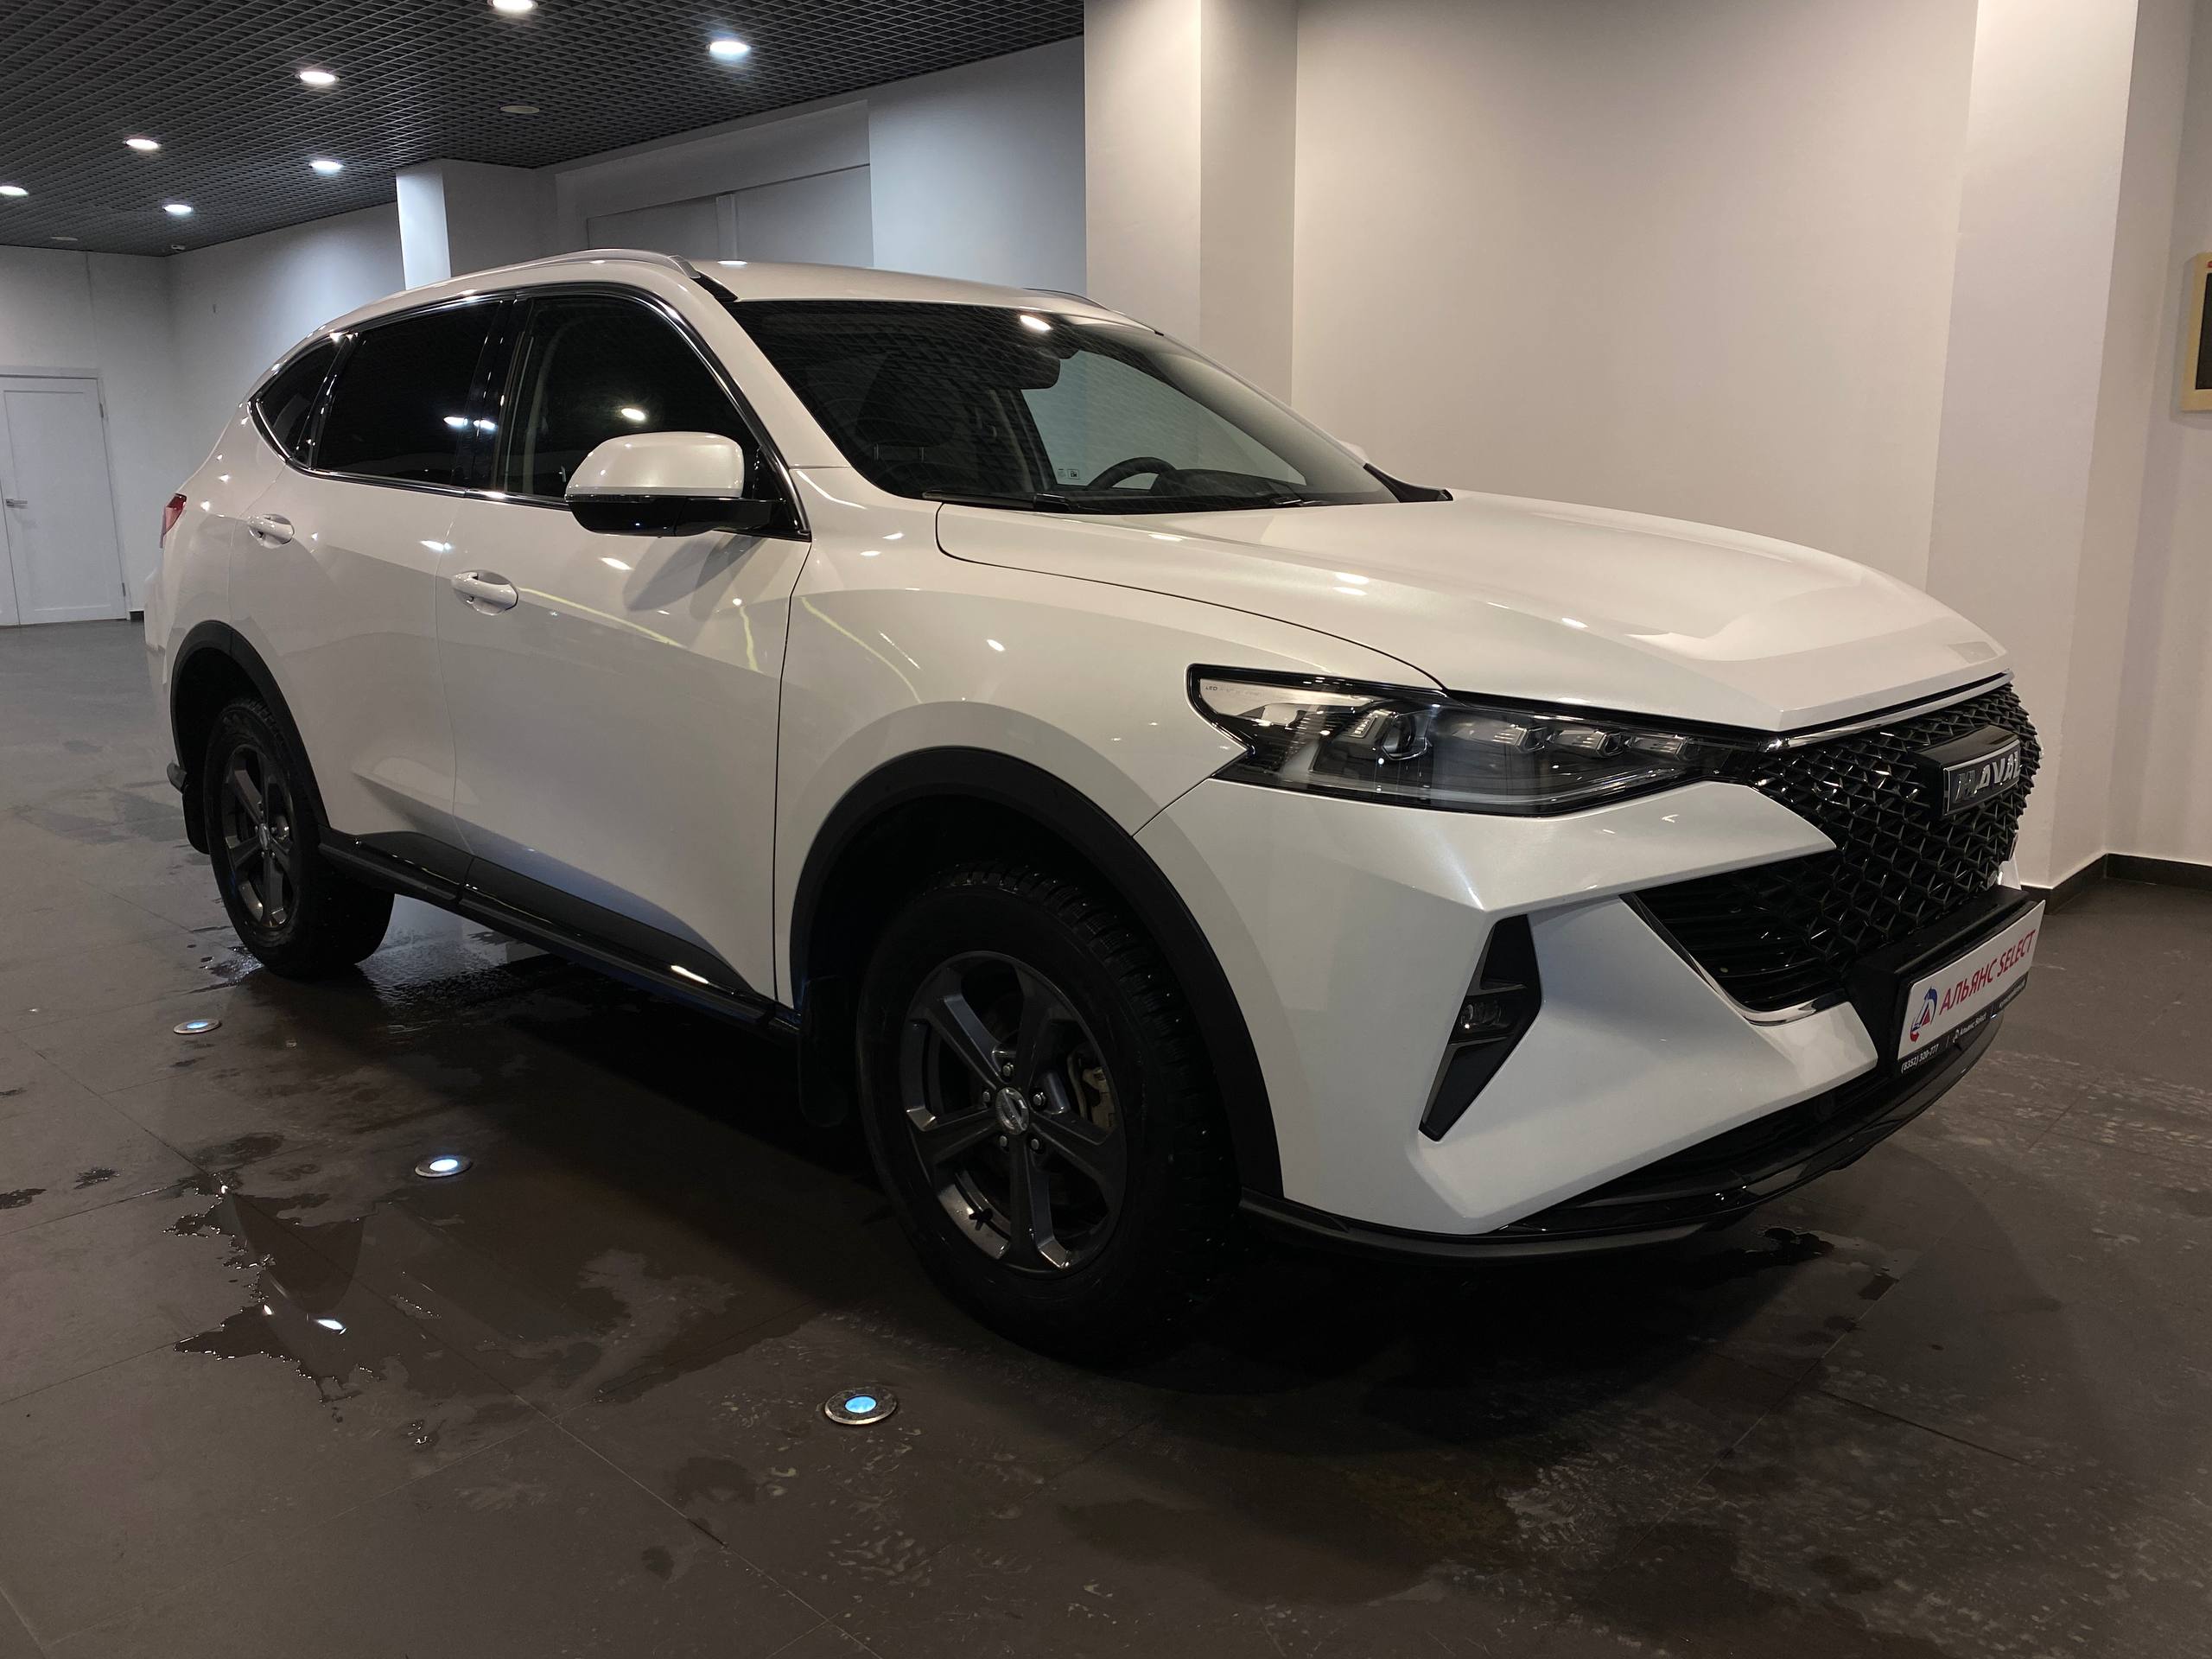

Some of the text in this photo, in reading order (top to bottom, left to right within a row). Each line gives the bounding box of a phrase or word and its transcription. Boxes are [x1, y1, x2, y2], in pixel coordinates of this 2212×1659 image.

[1955, 751, 2021, 803] HAVAL
[1939, 958, 1997, 1015] АЛЬЯНС
[1997, 929, 2037, 977] SELECT
